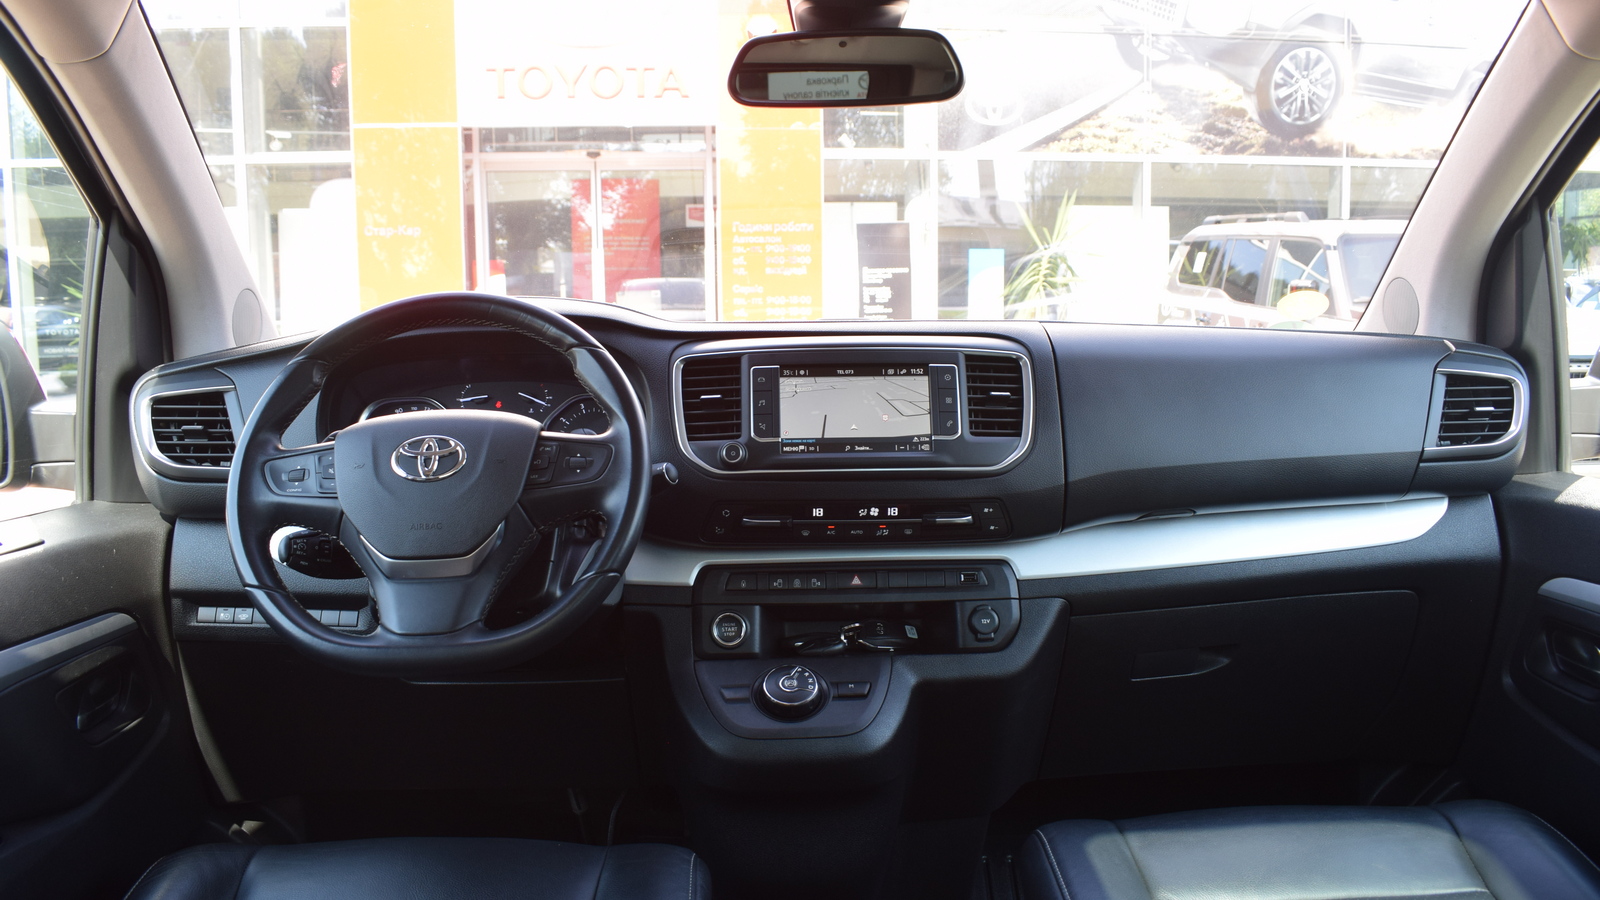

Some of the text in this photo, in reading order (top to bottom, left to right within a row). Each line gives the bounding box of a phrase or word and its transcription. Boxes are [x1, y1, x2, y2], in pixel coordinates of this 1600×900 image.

[486, 65, 689, 100] TOYOTA
[364, 225, 421, 239] Стар-Кар
[732, 221, 814, 234] Години роботи
[732, 235, 782, 244] Автосалон
[732, 284, 764, 295] Сервіс
[45, 328, 80, 336] TOYOTA
[812, 508, 823, 517] 18
[887, 507, 899, 516] 18
[409, 522, 443, 531] AIRBAG
